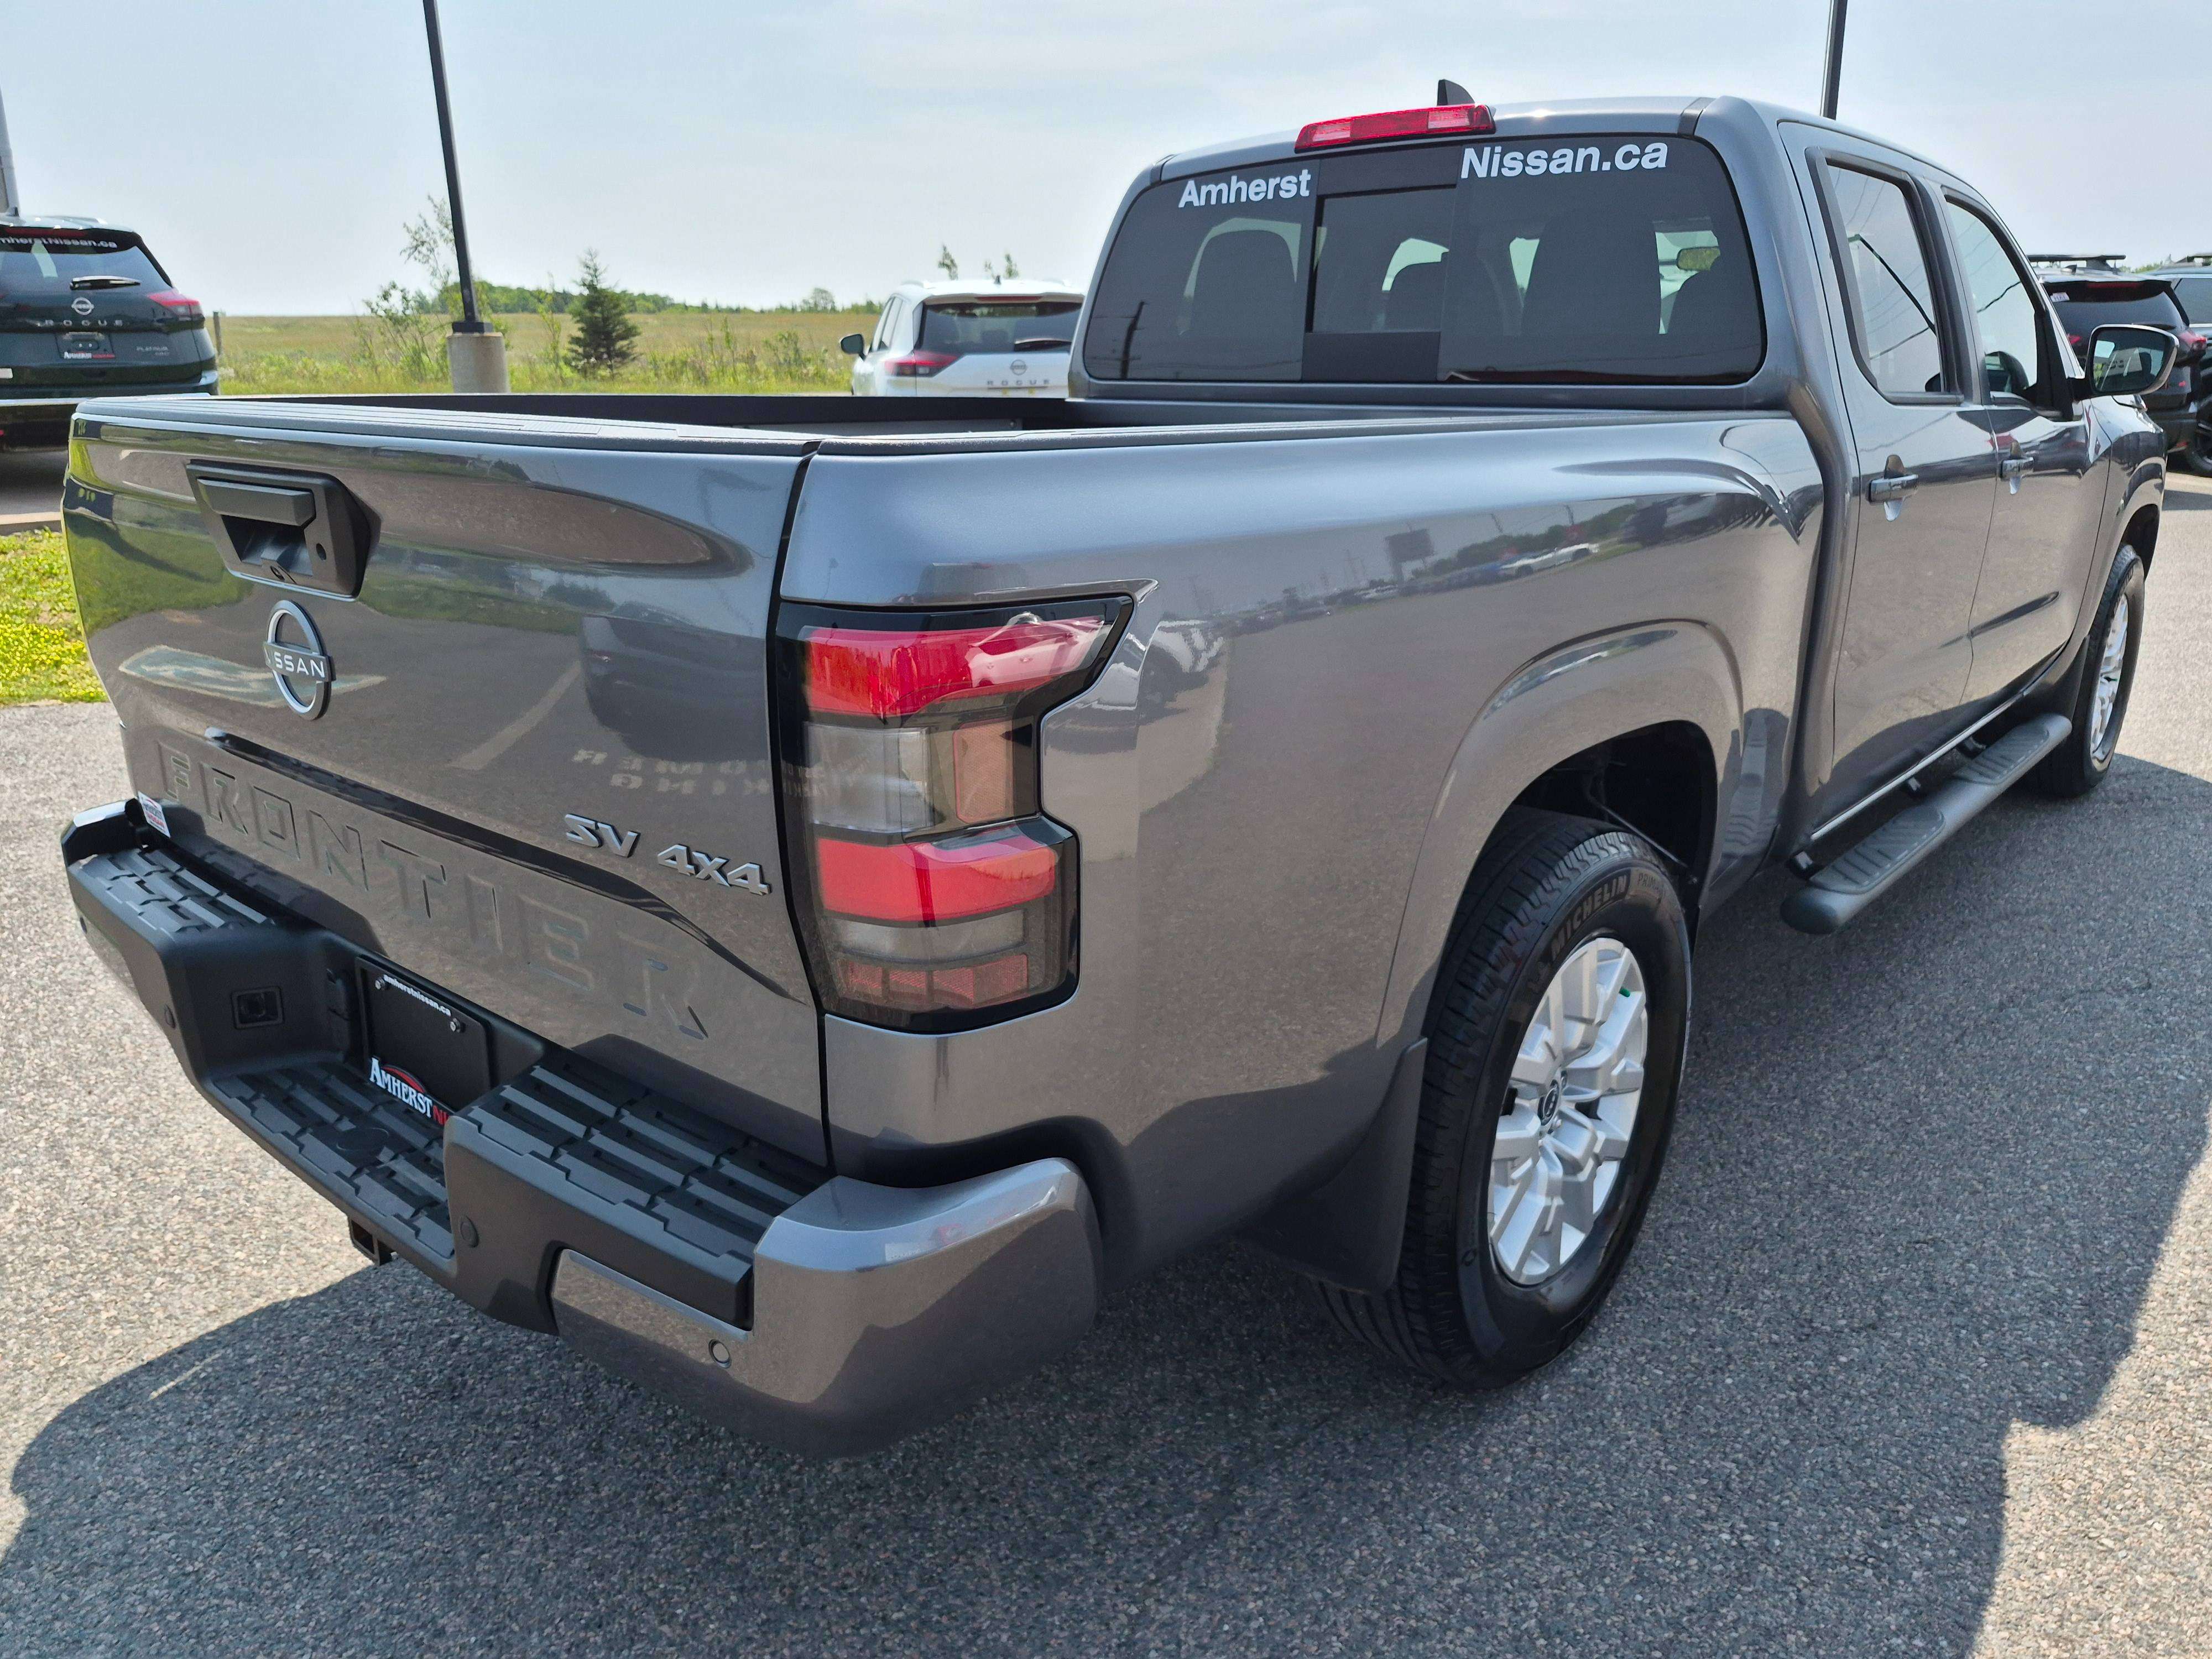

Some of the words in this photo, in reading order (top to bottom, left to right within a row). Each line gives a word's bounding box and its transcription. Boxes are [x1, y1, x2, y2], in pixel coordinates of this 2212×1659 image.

[1178, 169, 1312, 208] Amherst
[1460, 142, 1668, 179] Nissan.ca
[264, 647, 325, 678] SSAN
[564, 813, 640, 858] SV
[157, 740, 710, 1041] FRONTIER
[1551, 874, 1628, 961] MICHELIN
[383, 974, 451, 1016] amherstnissan.ca
[369, 1057, 433, 1118] AMHERST
